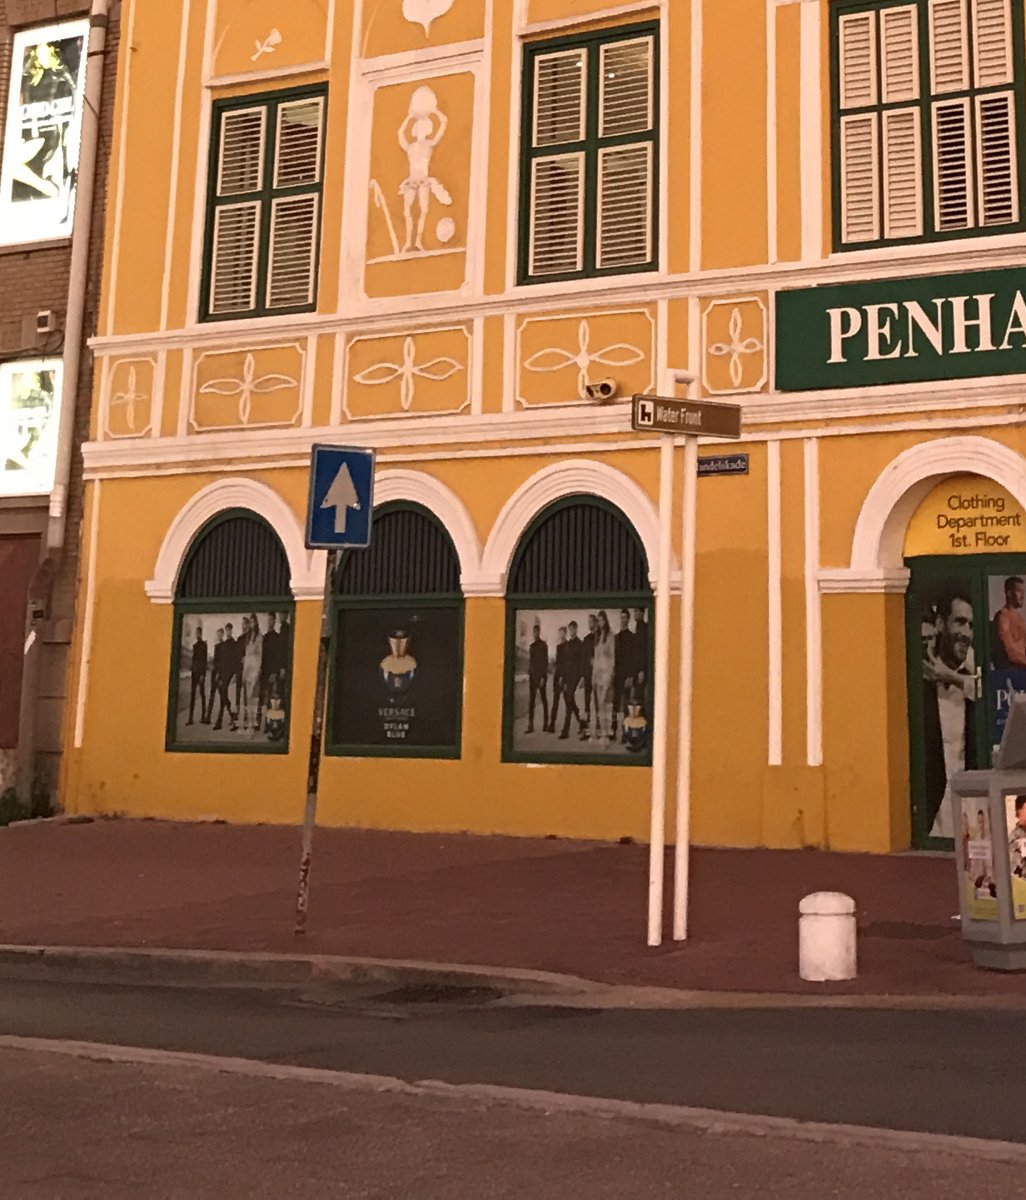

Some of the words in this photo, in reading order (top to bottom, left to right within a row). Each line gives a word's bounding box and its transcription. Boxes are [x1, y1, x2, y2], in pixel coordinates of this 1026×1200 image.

[656, 405, 679, 423] Water
[680, 407, 702, 426] Front
[696, 458, 747, 472] andelskade
[947, 493, 1005, 513] Clothing
[936, 512, 1021, 533] Department
[948, 532, 971, 548] 1st.
[975, 531, 1010, 548] Floor
